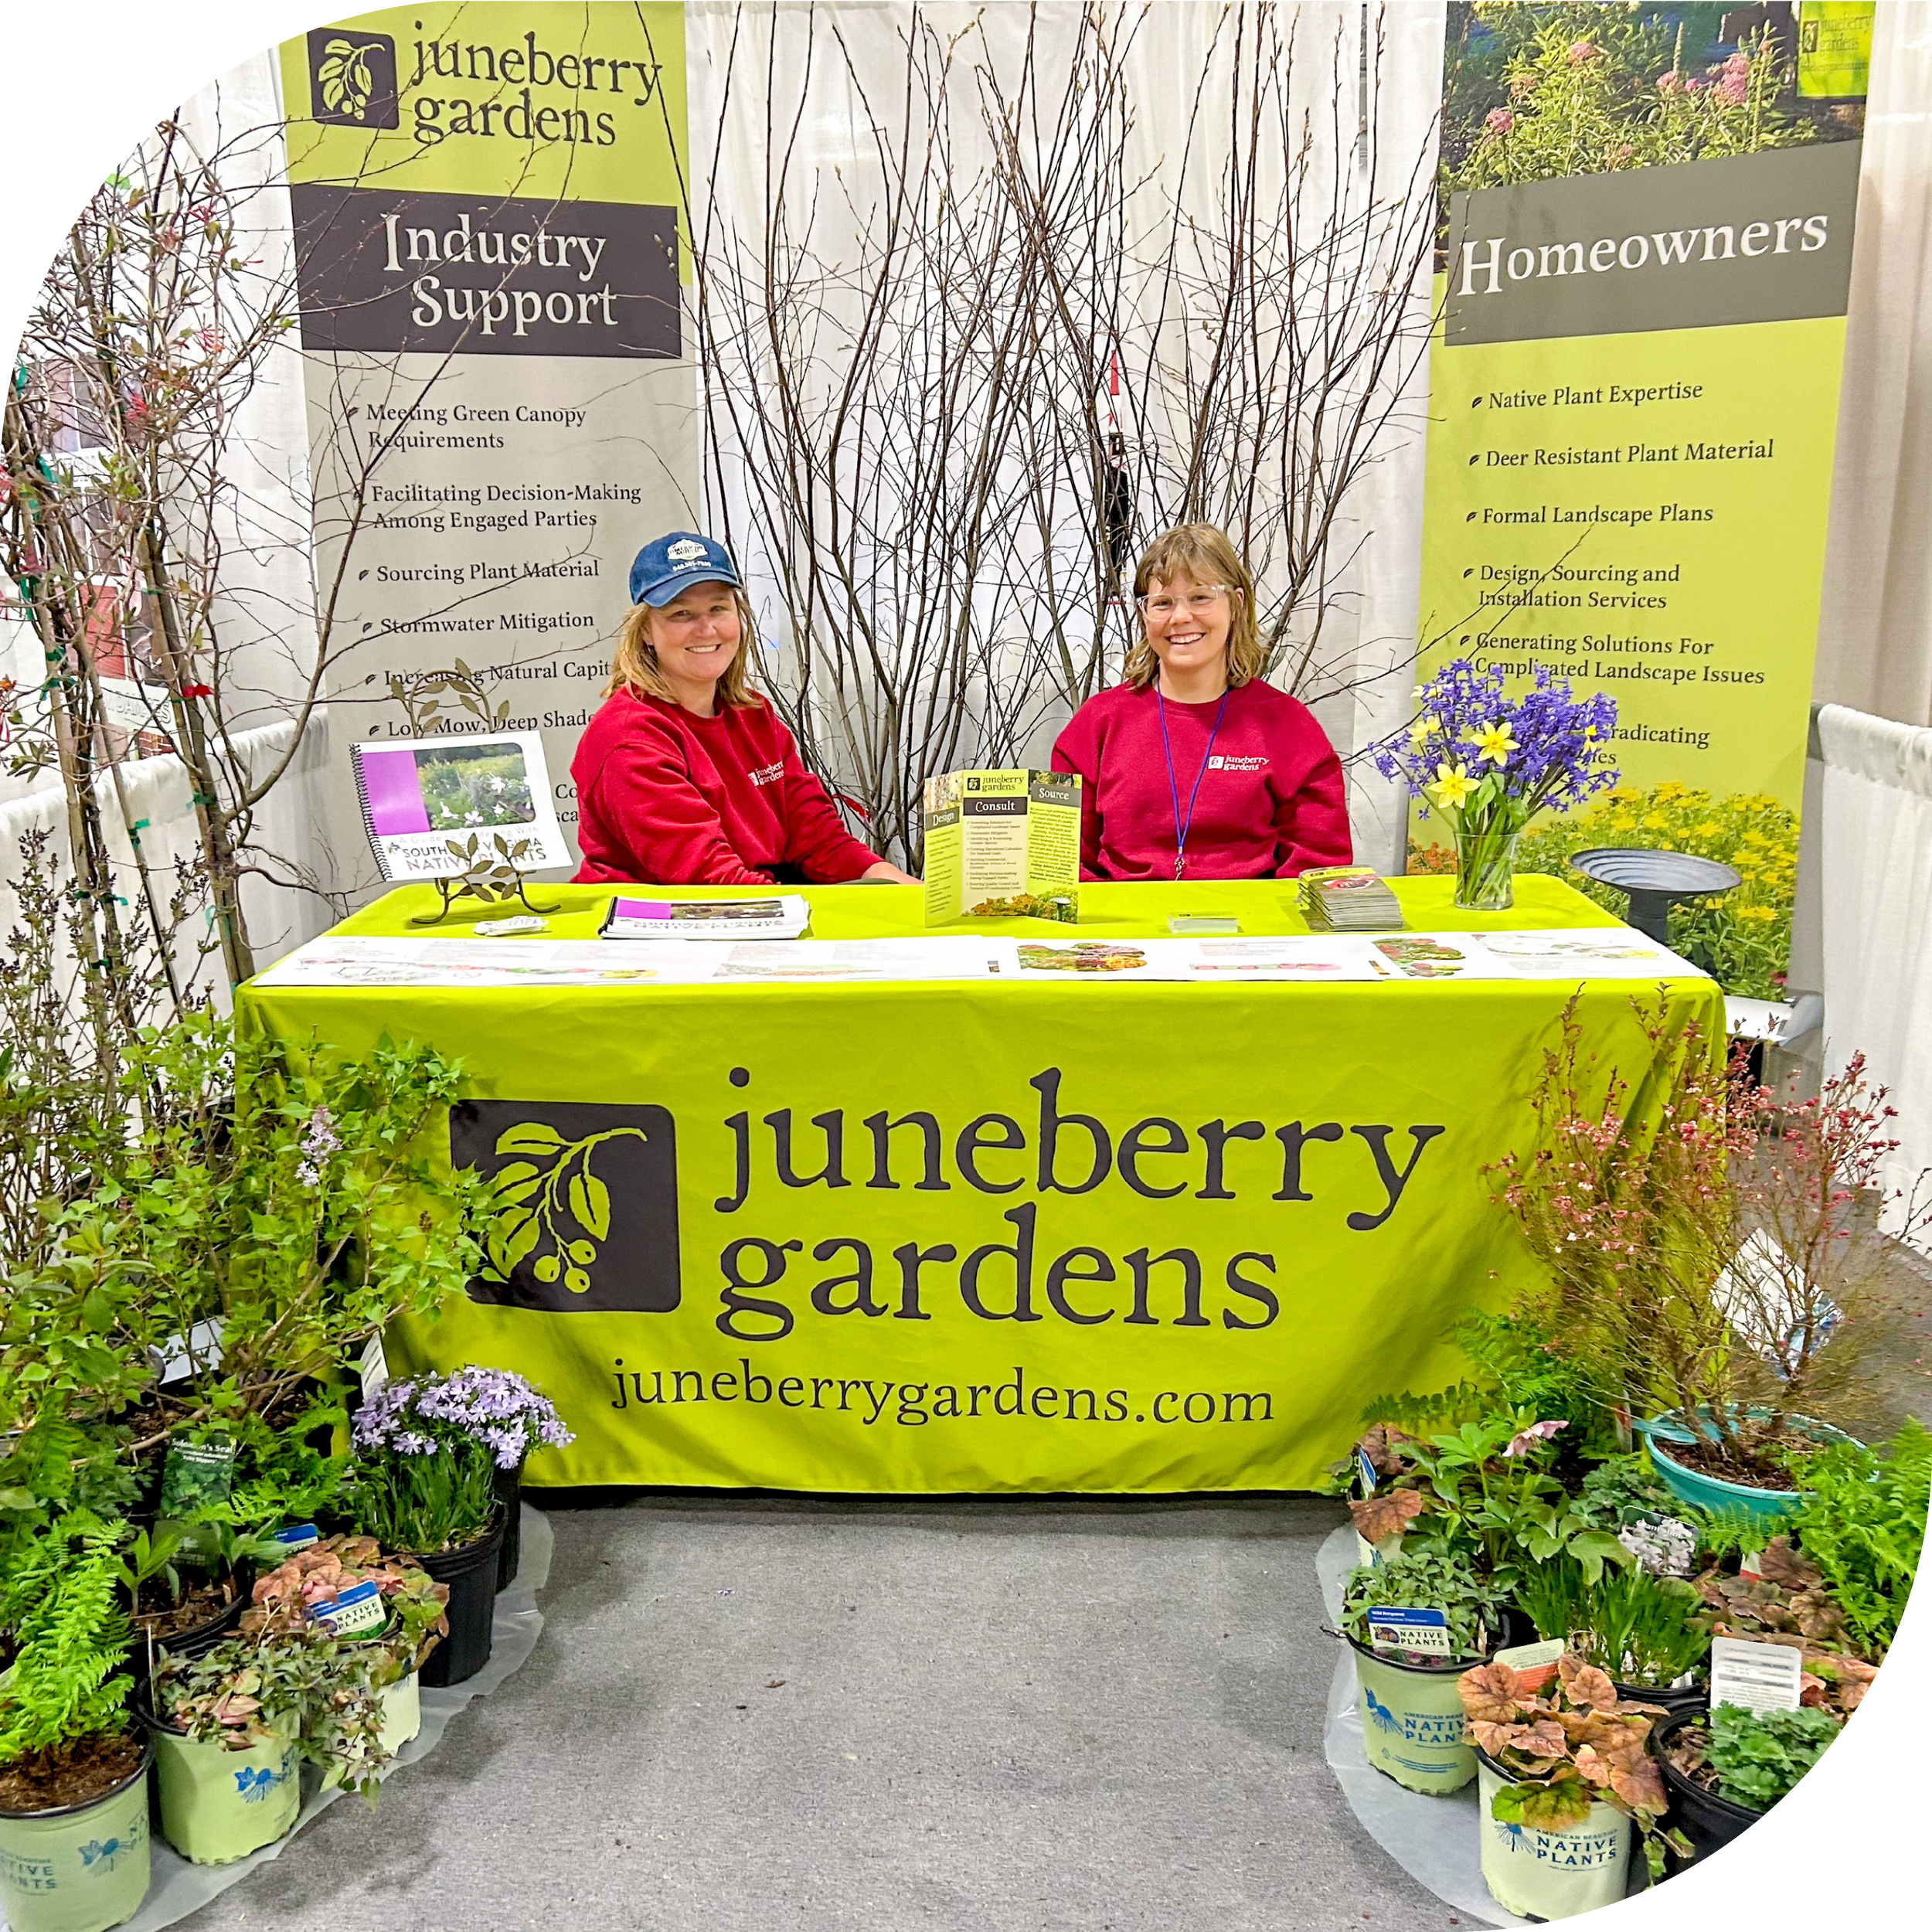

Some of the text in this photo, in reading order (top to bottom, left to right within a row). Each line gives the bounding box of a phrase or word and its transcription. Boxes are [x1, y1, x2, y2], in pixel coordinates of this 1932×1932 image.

[412, 20, 662, 106] juneberry
[413, 87, 617, 145] gardens
[380, 213, 607, 281] Industry
[1457, 215, 1828, 297] Homeowners
[411, 274, 619, 336] Support
[1488, 382, 1703, 410] Native Plant Expertise
[366, 403, 587, 428] Meeting Green Canopy
[369, 430, 505, 453] Requirements
[1485, 439, 1774, 467] Deer Resistant Plant Material
[372, 482, 641, 505] Facilitating Decision-Making
[373, 509, 597, 532] Among Engaged Parties
[1482, 504, 1714, 527] Formal Landscape Plans
[376, 560, 599, 584] Sourcing Plant Material
[1480, 565, 1680, 586] Design, Sourcing and
[1478, 590, 1667, 609] Installation Services
[380, 611, 594, 634] Stormwater Mitigation
[1477, 632, 1714, 655] Generating Solutions For
[489, 662, 558, 681] Natural
[563, 660, 612, 681] Capit
[1594, 660, 1697, 685] Landscape
[1702, 665, 1765, 684] Issues
[434, 718, 486, 733] Mow,
[1611, 723, 1710, 750] radicating
[755, 760, 784, 778] juneberr
[1223, 763, 1260, 771] gardens
[1225, 755, 1270, 765] juneberry
[981, 774, 1025, 784] juneberry
[981, 781, 1016, 792] gardens
[1039, 787, 1070, 800] Source
[975, 801, 1015, 812] Consult
[933, 811, 954, 827] Design
[410, 835, 441, 844] Guide
[515, 826, 539, 835] With
[713, 1066, 1446, 1230] juneberry
[716, 1201, 1280, 1342] gardens
[611, 1358, 1275, 1426] juneberrygardens.com
[172, 1437, 233, 1453] Solomn's Seal
[337, 1601, 378, 1622] NATIVE
[338, 1607, 380, 1629] PLANTS
[1404, 1718, 1464, 1731] NATIV
[1404, 1730, 1464, 1743] PLAN
[1536, 1828, 1580, 1839] AMERICAN
[1537, 1835, 1617, 1852] NATIVE
[1536, 1848, 1617, 1865] PLANTS
